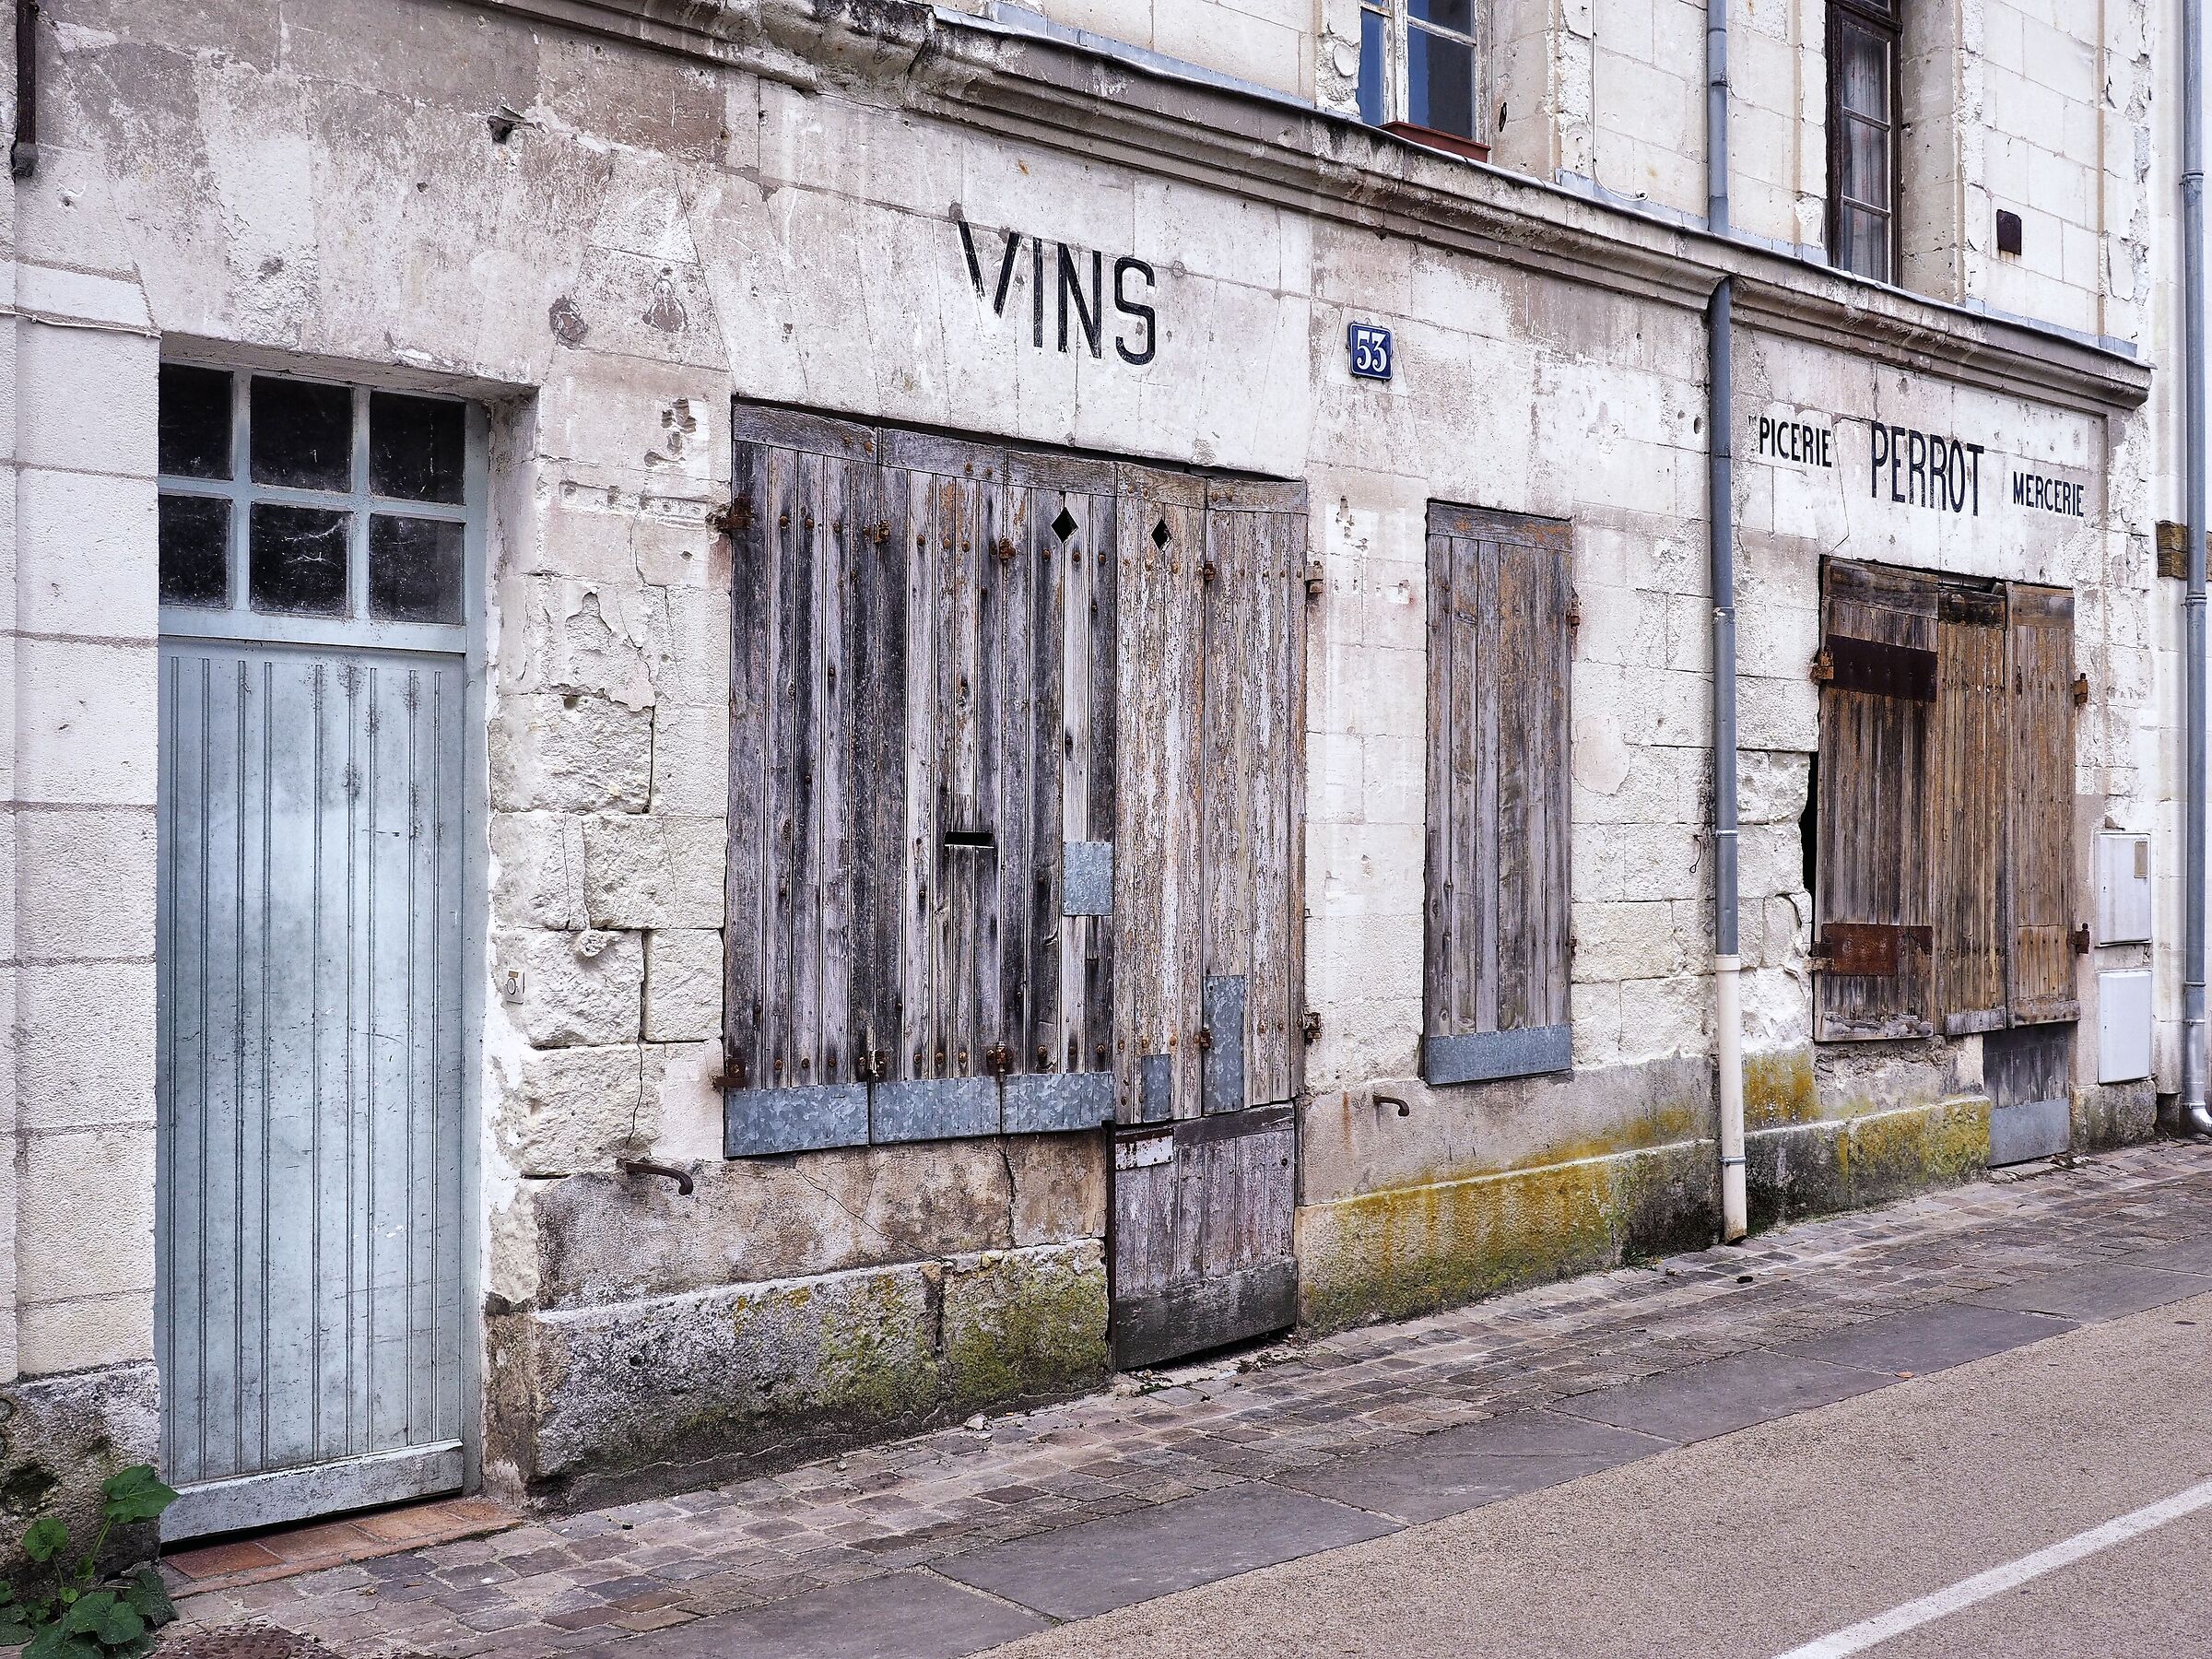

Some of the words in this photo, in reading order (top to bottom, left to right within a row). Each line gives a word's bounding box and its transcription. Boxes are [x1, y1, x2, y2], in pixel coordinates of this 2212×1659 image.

[957, 220, 1156, 366] VINS
[1356, 329, 1387, 372] 53
[1748, 415, 1832, 468] PICERIE
[1871, 421, 1984, 517] PERROT
[2013, 470, 2085, 518] MERCERIE
